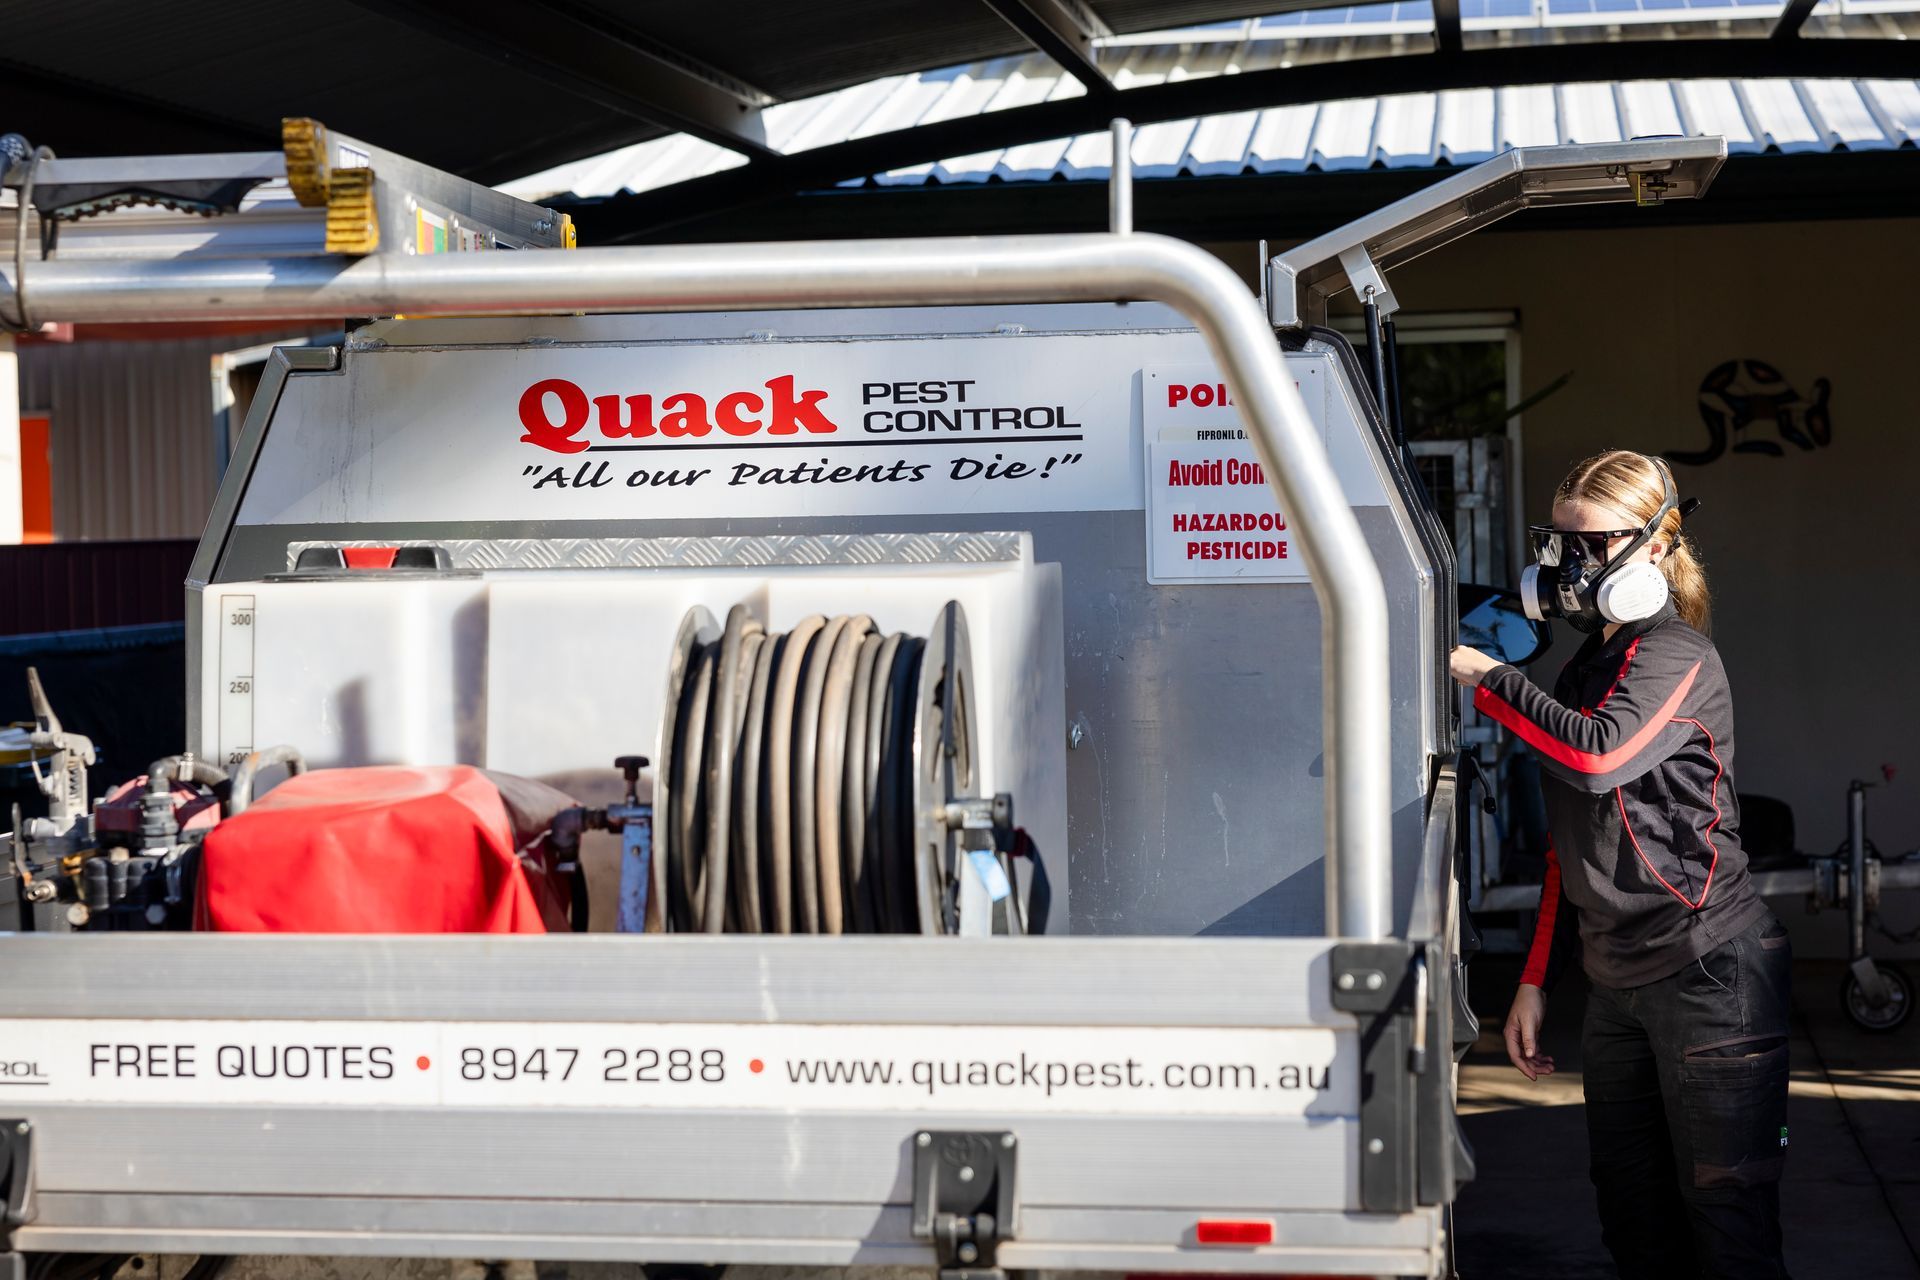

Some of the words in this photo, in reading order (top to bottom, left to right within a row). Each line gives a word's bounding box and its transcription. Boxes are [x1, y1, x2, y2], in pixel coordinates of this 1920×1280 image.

[862, 380, 975, 405] PEST
[519, 375, 837, 454] Quack
[863, 406, 1081, 433] CONTROL
[1197, 430, 1235, 440] FIPRONIL
[626, 469, 711, 487] our
[728, 458, 931, 486] Patients
[1168, 459, 1222, 486] Avoid
[1226, 458, 1269, 485] Con
[1173, 512, 1287, 532] HAZARDOU
[1187, 541, 1288, 560] PESTICIDE
[231, 614, 251, 625] 300
[230, 682, 250, 693] 250
[90, 1044, 196, 1077] FREE
[217, 1046, 394, 1079] QUOTES
[461, 1048, 579, 1080] 8947
[603, 1049, 725, 1082] 2288
[786, 1053, 1331, 1096] www.quackpest.com.au
